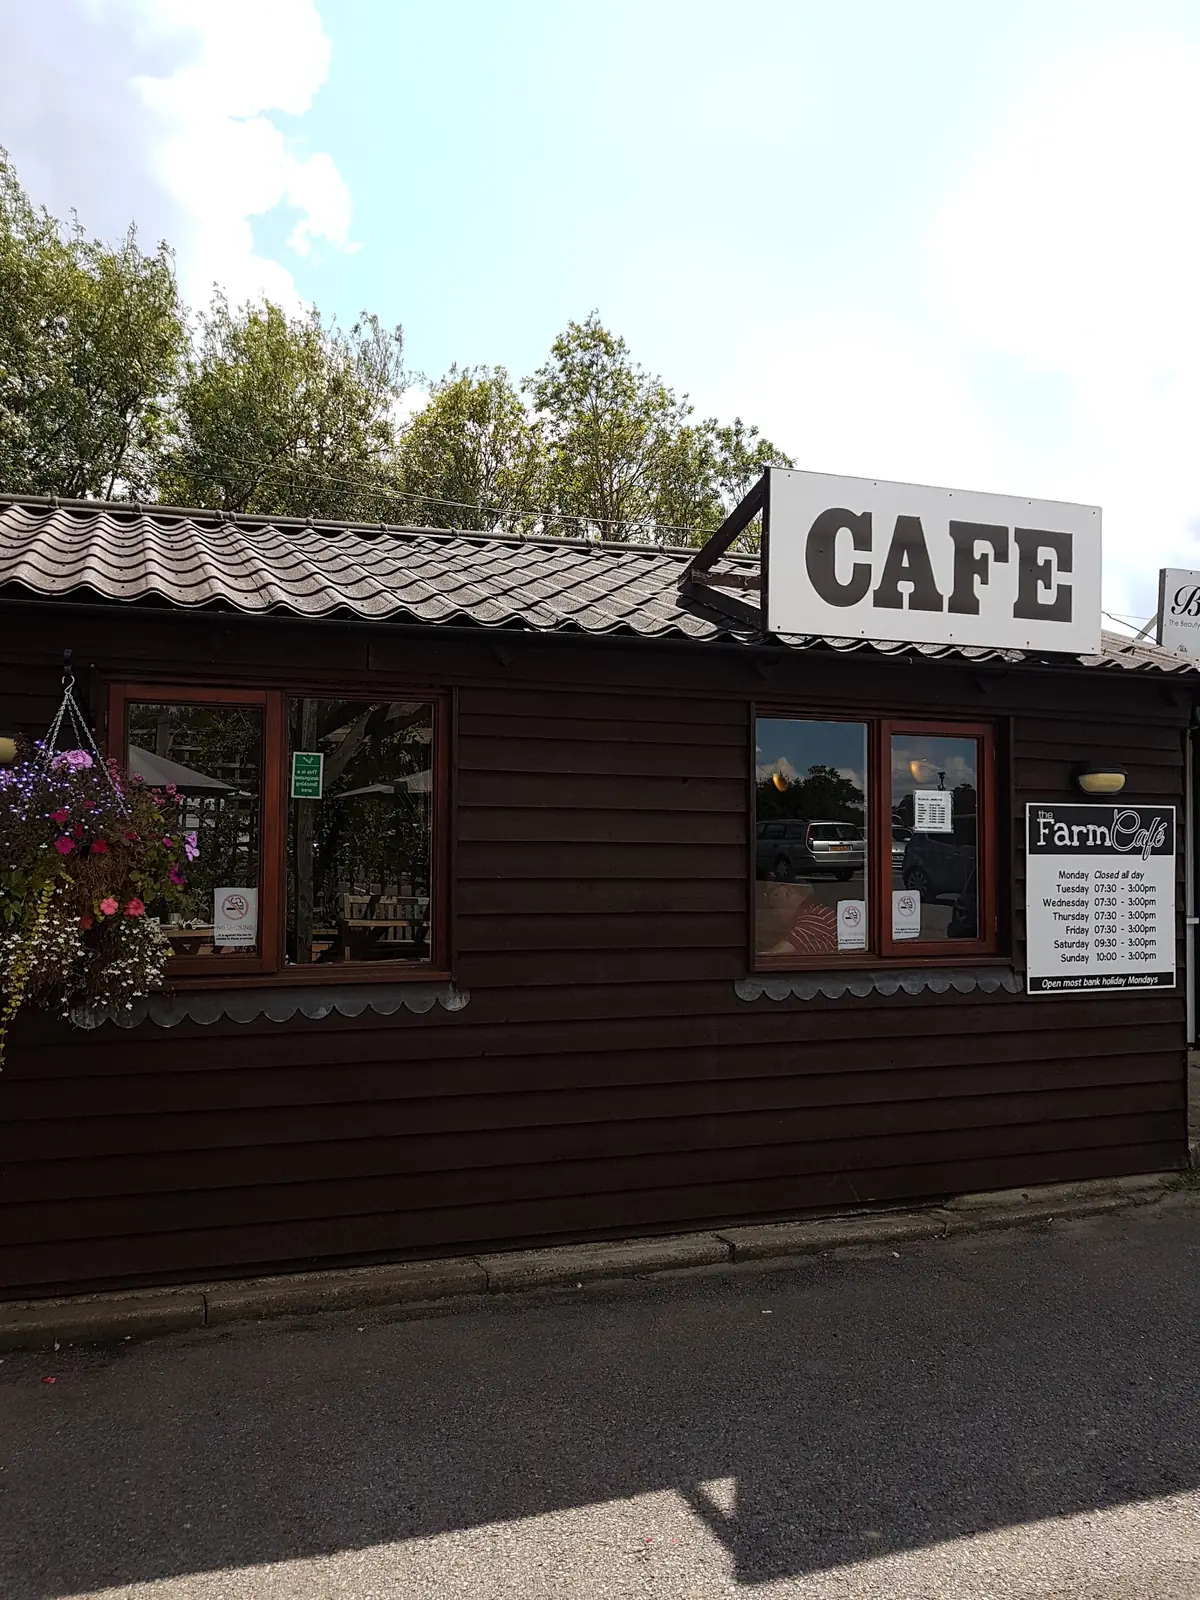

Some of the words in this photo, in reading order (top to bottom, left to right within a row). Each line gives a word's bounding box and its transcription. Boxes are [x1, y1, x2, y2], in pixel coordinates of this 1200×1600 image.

[805, 507, 1073, 623] CAFE
[1038, 810, 1053, 819] the
[1037, 819, 1111, 846] Farm
[1110, 809, 1167, 860] Café
[1059, 871, 1089, 881] Monday
[1094, 870, 1120, 879] Closed
[1121, 870, 1129, 878] all
[1131, 871, 1144, 881] day
[1056, 884, 1089, 895] Tuesday
[1094, 884, 1116, 892] 07:30
[1128, 884, 1156, 894] 3:00pm
[1043, 898, 1089, 909] Wednesday
[1094, 898, 1116, 906] 07:30
[1128, 898, 1156, 908] 3:00pm
[1053, 912, 1089, 922] Thursday
[1094, 912, 1116, 920] 07:30
[1128, 911, 1156, 921] 3:00pm
[1066, 926, 1089, 936] Friday
[1094, 925, 1116, 933] 07:30
[1128, 925, 1156, 934] 3:00pm
[1054, 940, 1089, 950] Saturday
[1094, 938, 1116, 947] 09:30
[1128, 938, 1156, 948] 3:00pm
[1061, 953, 1089, 964] Sunday
[1097, 952, 1116, 961] 10:00
[1128, 952, 1156, 962] 3:00pm
[1042, 979, 1061, 989] Open
[1063, 979, 1082, 987] most
[1083, 978, 1100, 986] bank
[1102, 977, 1126, 986] holiday
[1128, 976, 1158, 985] Mondays
